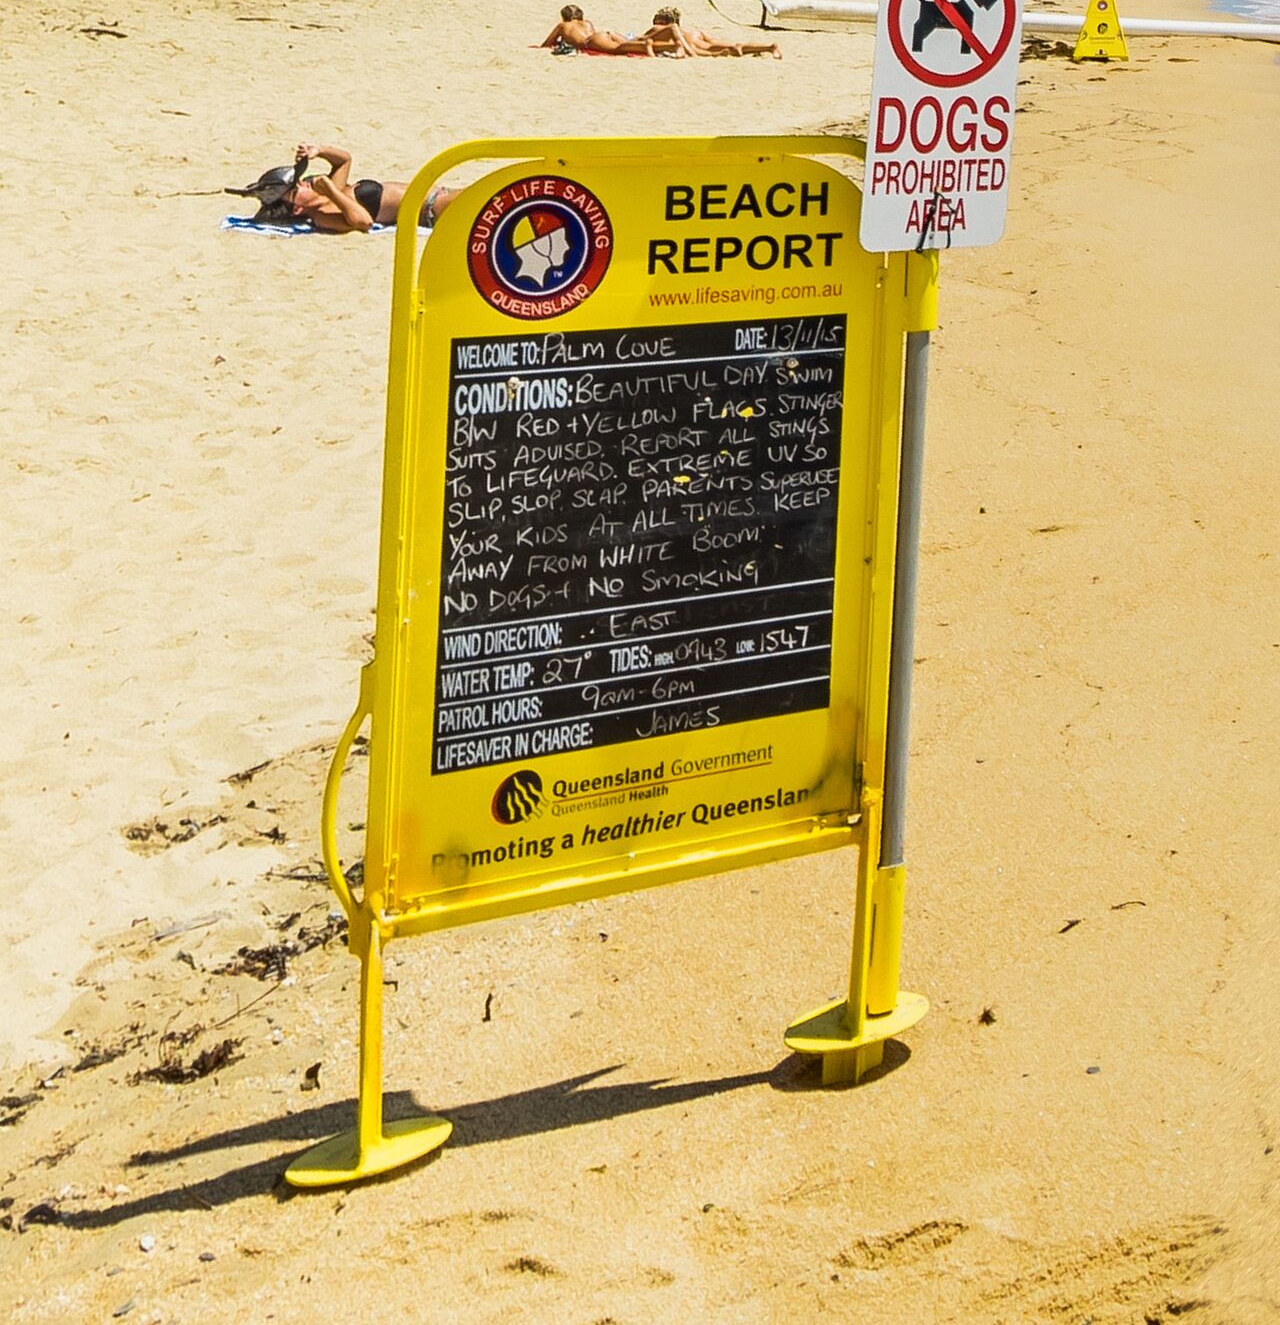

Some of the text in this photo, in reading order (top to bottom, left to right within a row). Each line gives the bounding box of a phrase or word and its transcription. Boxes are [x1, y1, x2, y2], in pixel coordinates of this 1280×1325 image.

[874, 95, 1010, 154] DOGS
[871, 158, 1006, 196] PROHIBITED
[472, 180, 610, 254] SURF LIFE SAVING
[665, 182, 829, 221] BEACH
[905, 198, 966, 234] AREA
[648, 232, 844, 275] REPORT
[490, 283, 589, 316] QUEENSLAND
[649, 283, 843, 307] www.lifesaving.com.au
[457, 341, 540, 370] WELCOME TO:
[542, 332, 605, 365] PALM
[735, 327, 767, 351] DATE:
[454, 377, 573, 416] CONDITIONS:
[575, 369, 718, 404] BEAUTIFUL
[776, 367, 832, 387] SWIM
[453, 414, 497, 448] B/W
[517, 412, 560, 439] RED
[778, 391, 843, 417] STINGER
[446, 447, 496, 472] SUITS
[621, 427, 709, 456] REPORT
[719, 428, 757, 444] ALL
[769, 416, 830, 444] STINGS
[628, 449, 752, 477] EXTREME
[768, 444, 797, 462] UV
[642, 475, 753, 502] PARENTS
[449, 529, 502, 561] YOUR
[517, 524, 568, 548] KIDS
[589, 512, 624, 538] AT
[632, 507, 676, 533] ALL
[774, 487, 830, 512] KEEP
[448, 554, 514, 584] AWAY
[528, 555, 587, 576] FROM
[600, 542, 675, 568] WHITE
[444, 590, 478, 616] NO
[589, 576, 624, 598] NO
[444, 622, 563, 661] WIND DIRECTION:
[610, 610, 677, 639] EAST
[759, 625, 809, 653] 1547
[609, 644, 652, 674] TIDES:
[441, 661, 535, 699] WATER TEMP:
[438, 696, 543, 734] PATROL HOURS:
[636, 705, 720, 737] JAMES
[437, 721, 593, 770] LIFESAVER IN CHARGE:
[552, 744, 773, 798] Queensland Government
[551, 784, 669, 817] Queensland Health
[561, 833, 574, 850] a
[581, 811, 687, 847] healthier
